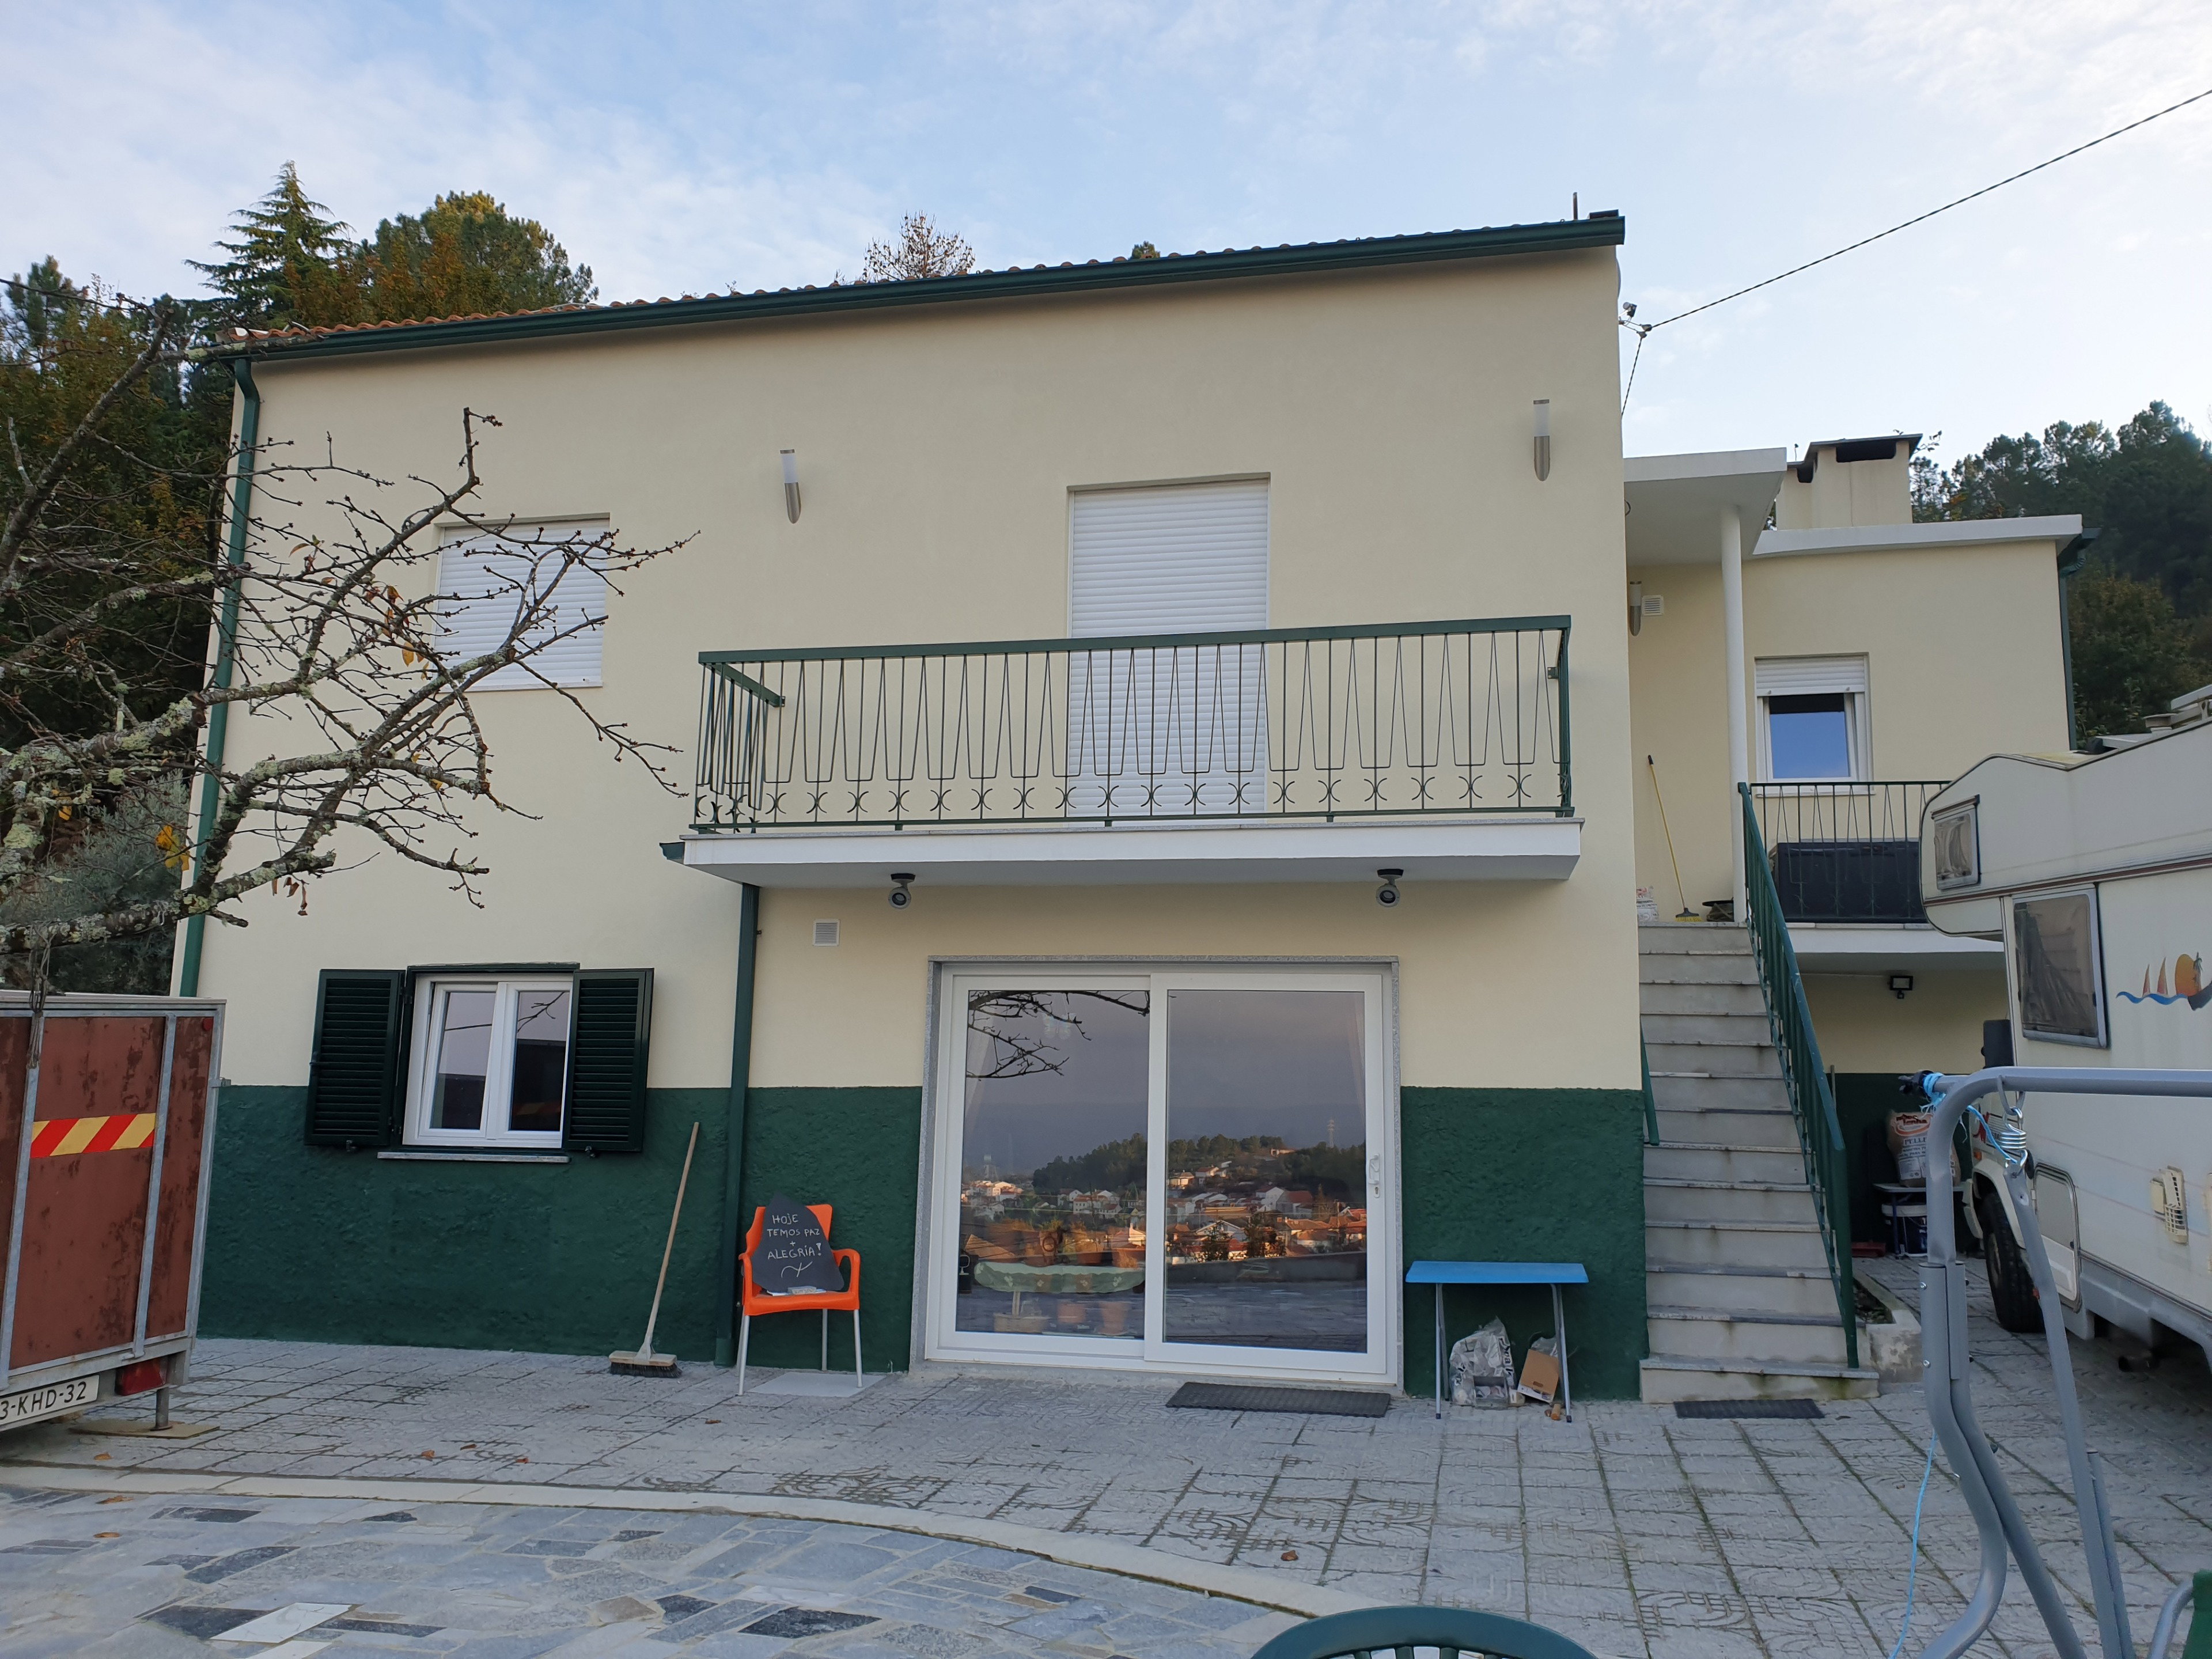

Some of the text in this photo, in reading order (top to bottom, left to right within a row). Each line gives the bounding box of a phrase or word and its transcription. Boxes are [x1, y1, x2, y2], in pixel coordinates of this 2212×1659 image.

[772, 1213, 798, 1225] HOJE
[767, 1229, 820, 1238] TEMOS PAZ
